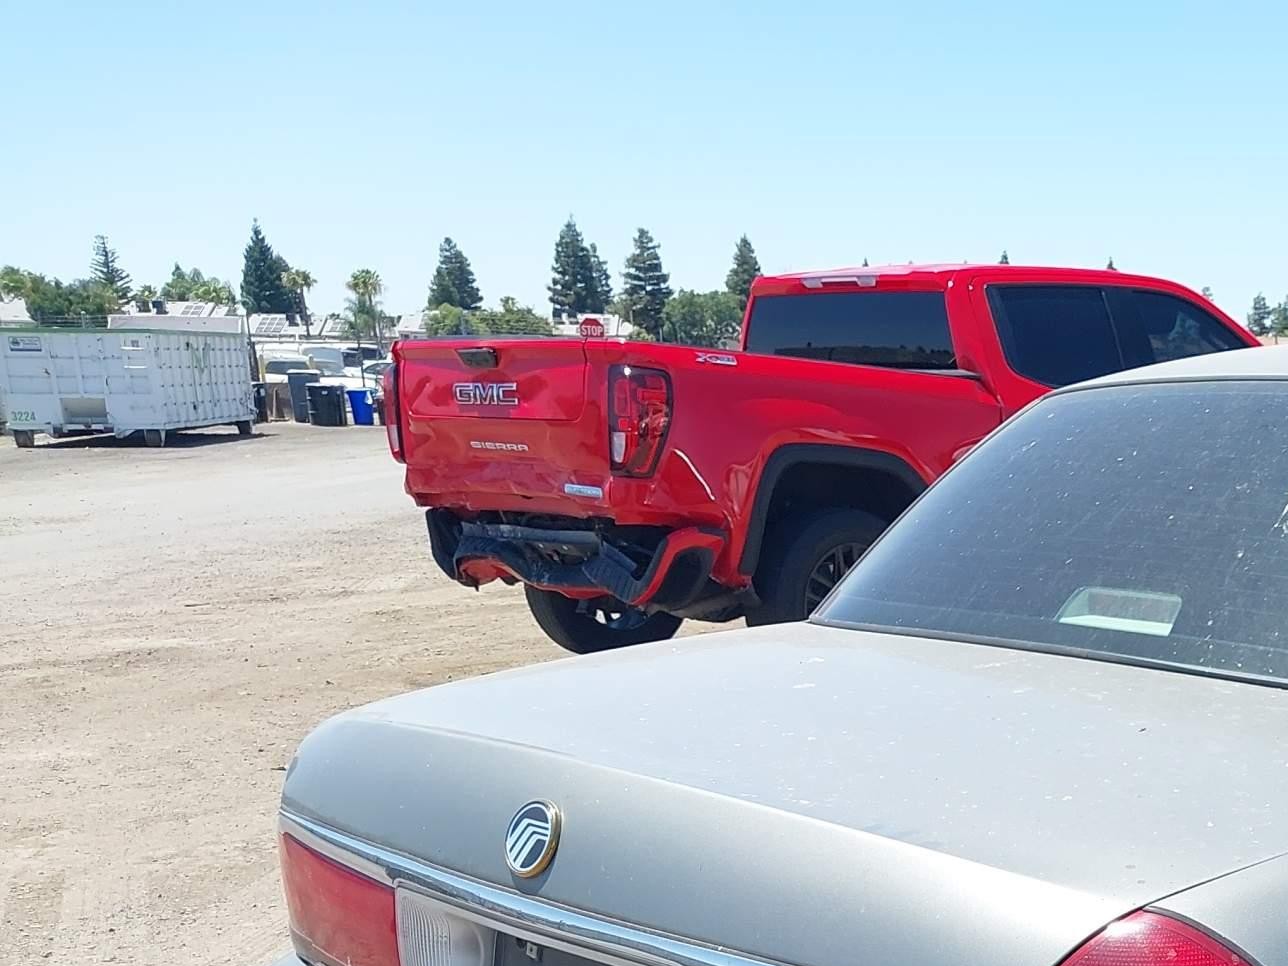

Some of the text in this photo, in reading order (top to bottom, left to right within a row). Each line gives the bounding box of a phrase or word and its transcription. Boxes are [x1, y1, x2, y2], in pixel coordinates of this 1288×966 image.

[581, 325, 603, 337] STOP
[453, 382, 518, 405] GMC
[11, 410, 36, 421] 3224
[470, 441, 529, 451] SIERRA
